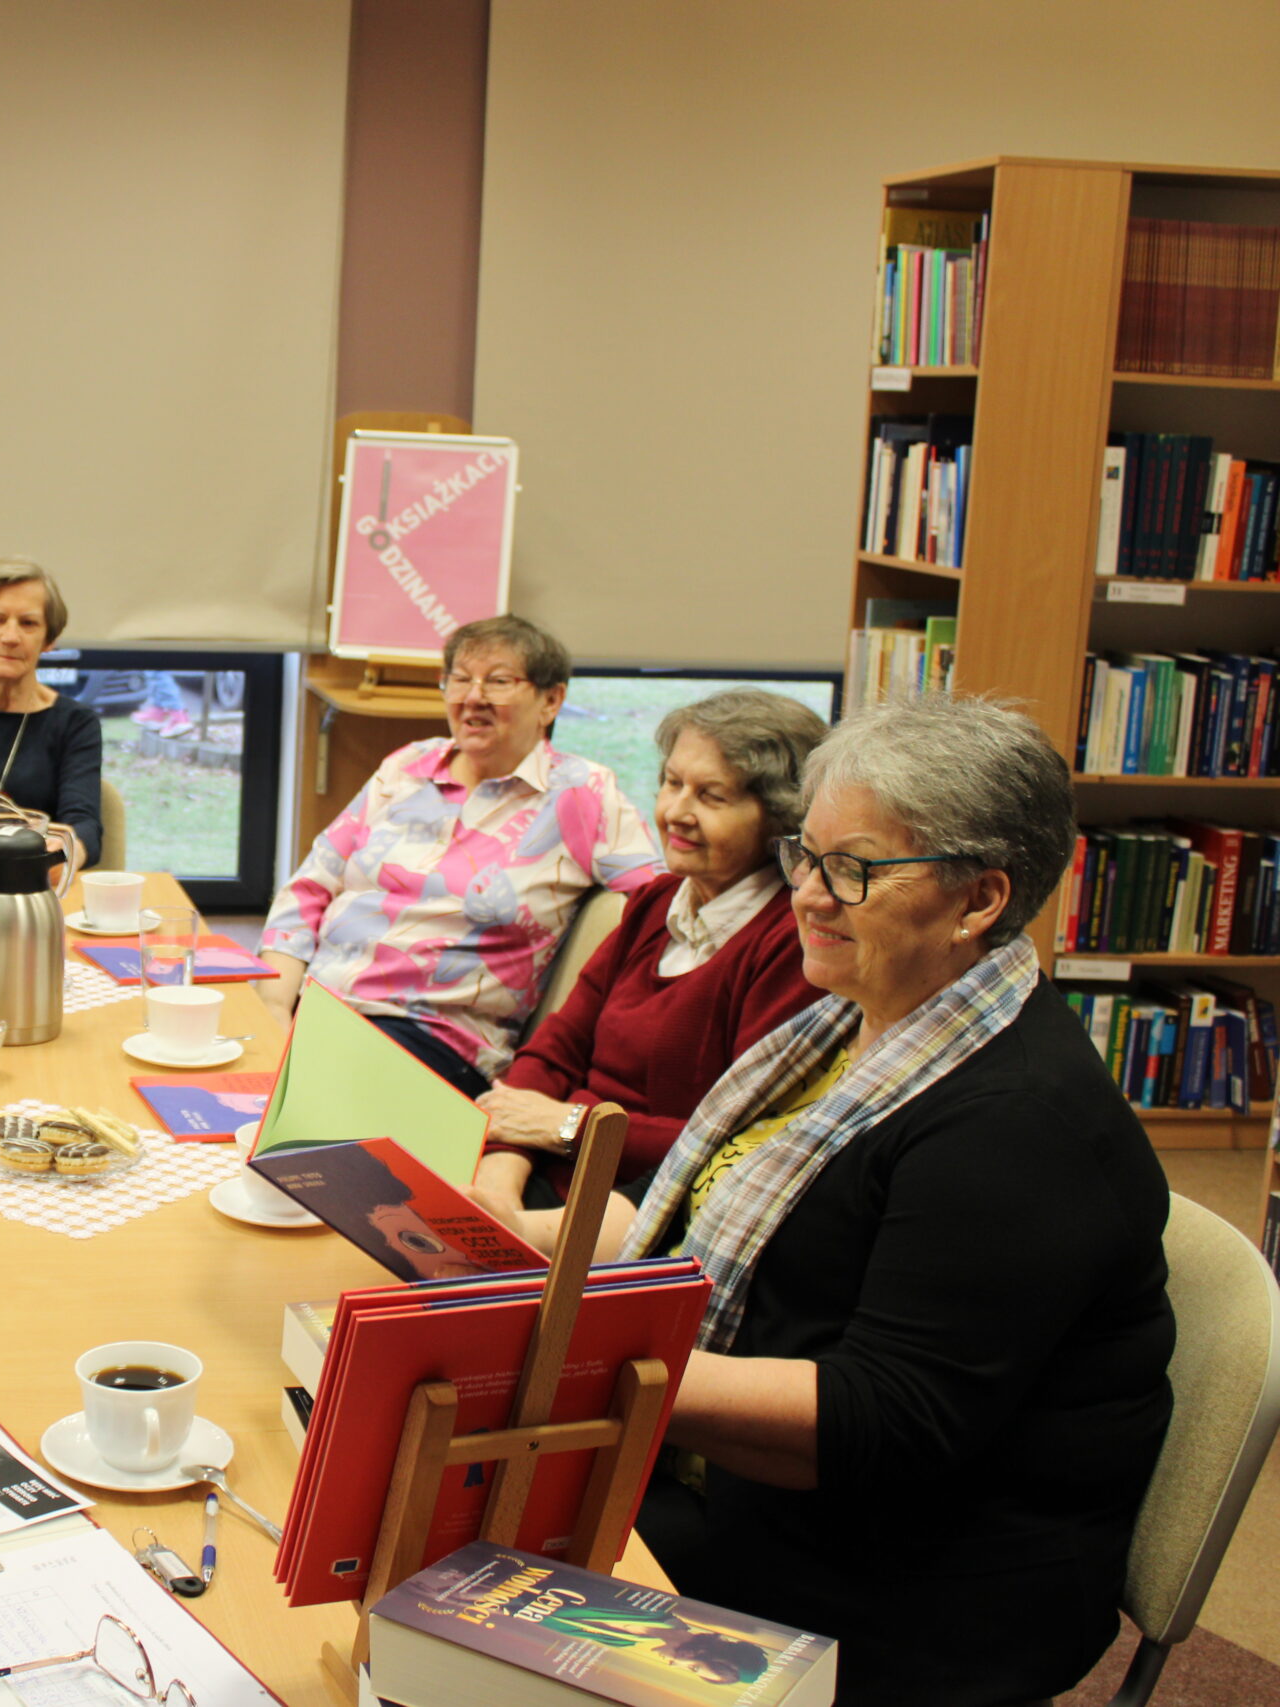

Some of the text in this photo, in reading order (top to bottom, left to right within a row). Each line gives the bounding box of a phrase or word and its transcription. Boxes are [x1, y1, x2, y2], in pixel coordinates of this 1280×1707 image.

[1213, 855, 1239, 951] MARKETING
[456, 1566, 555, 1629] wolności
[512, 1588, 587, 1623] Cena
[732, 1633, 816, 1707] BARBARA WYSOCZA
